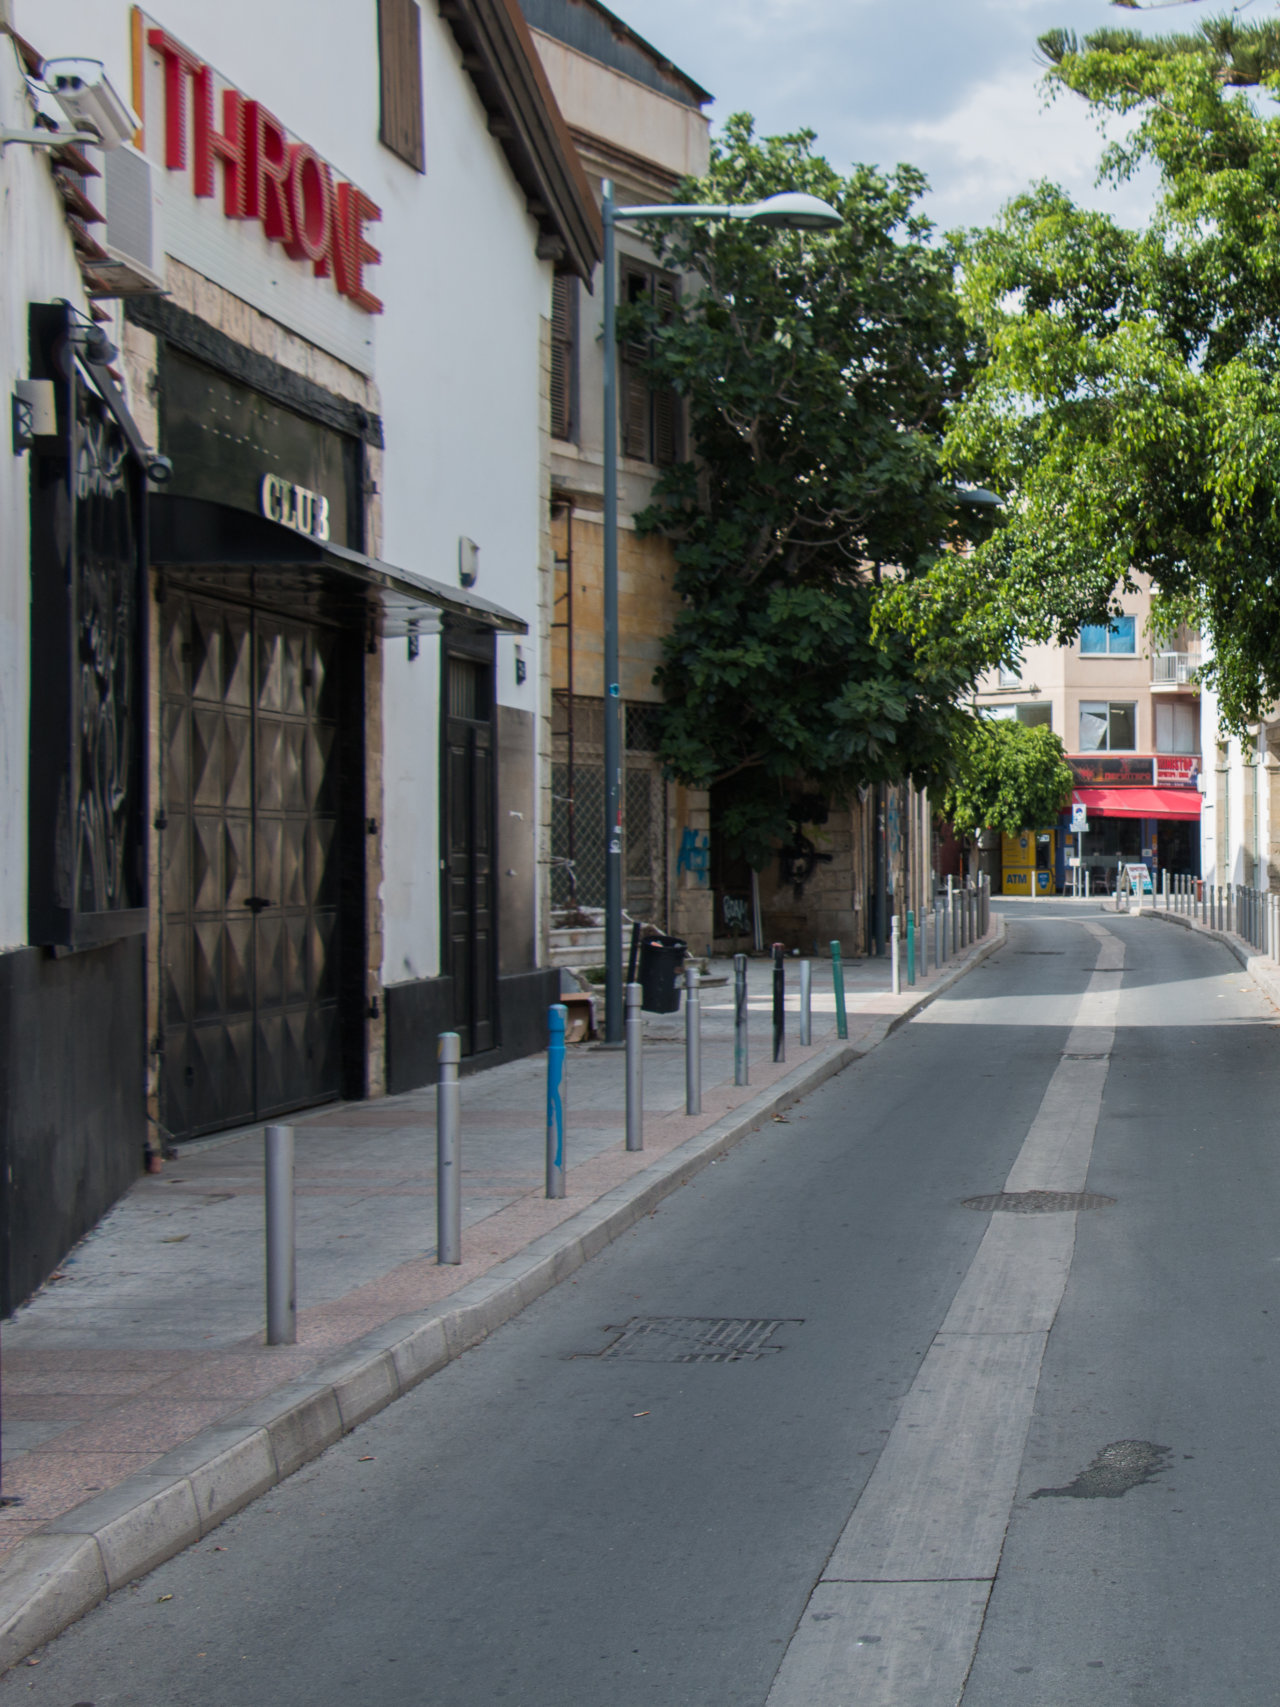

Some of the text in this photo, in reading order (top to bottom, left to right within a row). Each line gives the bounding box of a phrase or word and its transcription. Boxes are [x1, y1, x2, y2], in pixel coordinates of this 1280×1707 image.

[147, 28, 384, 315] THRONE
[260, 472, 330, 542] CLUB
[1006, 874, 1027, 884] ATM
